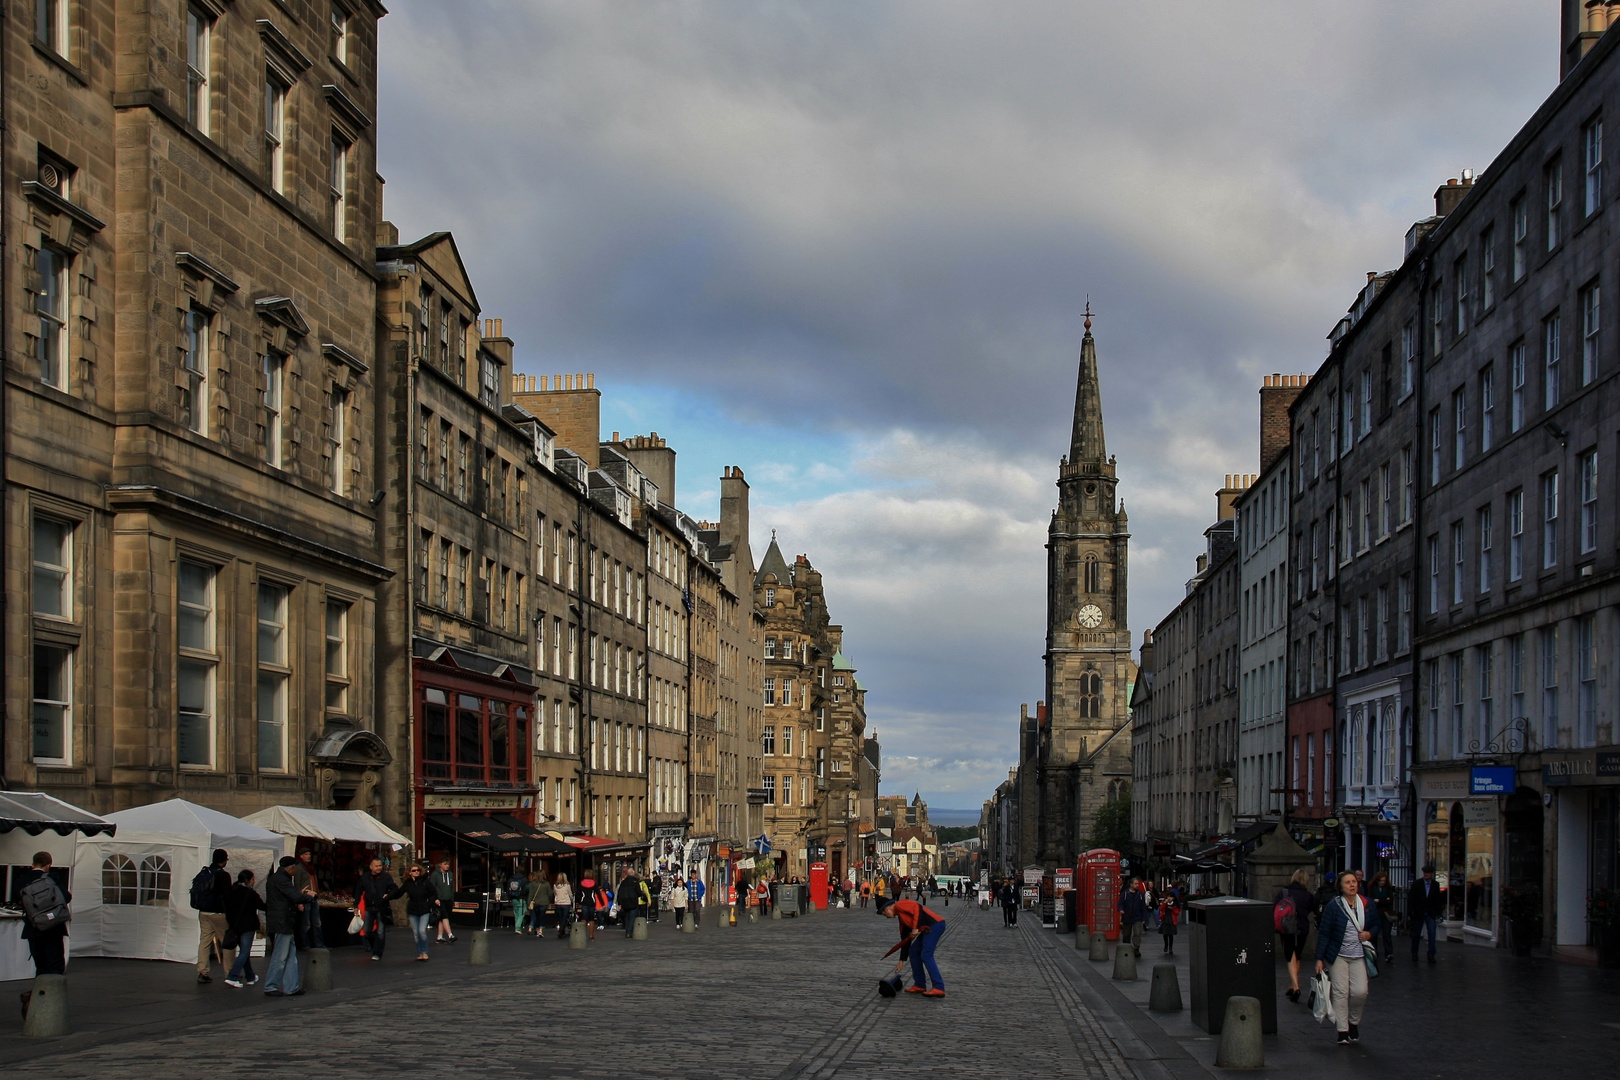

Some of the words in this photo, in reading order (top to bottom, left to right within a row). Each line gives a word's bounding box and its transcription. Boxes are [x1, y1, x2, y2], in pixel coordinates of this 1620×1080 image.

[36, 728, 49, 737] Hub
[1474, 777, 1492, 785] fringe
[440, 798, 453, 808] THE
[457, 798, 482, 808] FILLING
[484, 798, 507, 808] STATION
